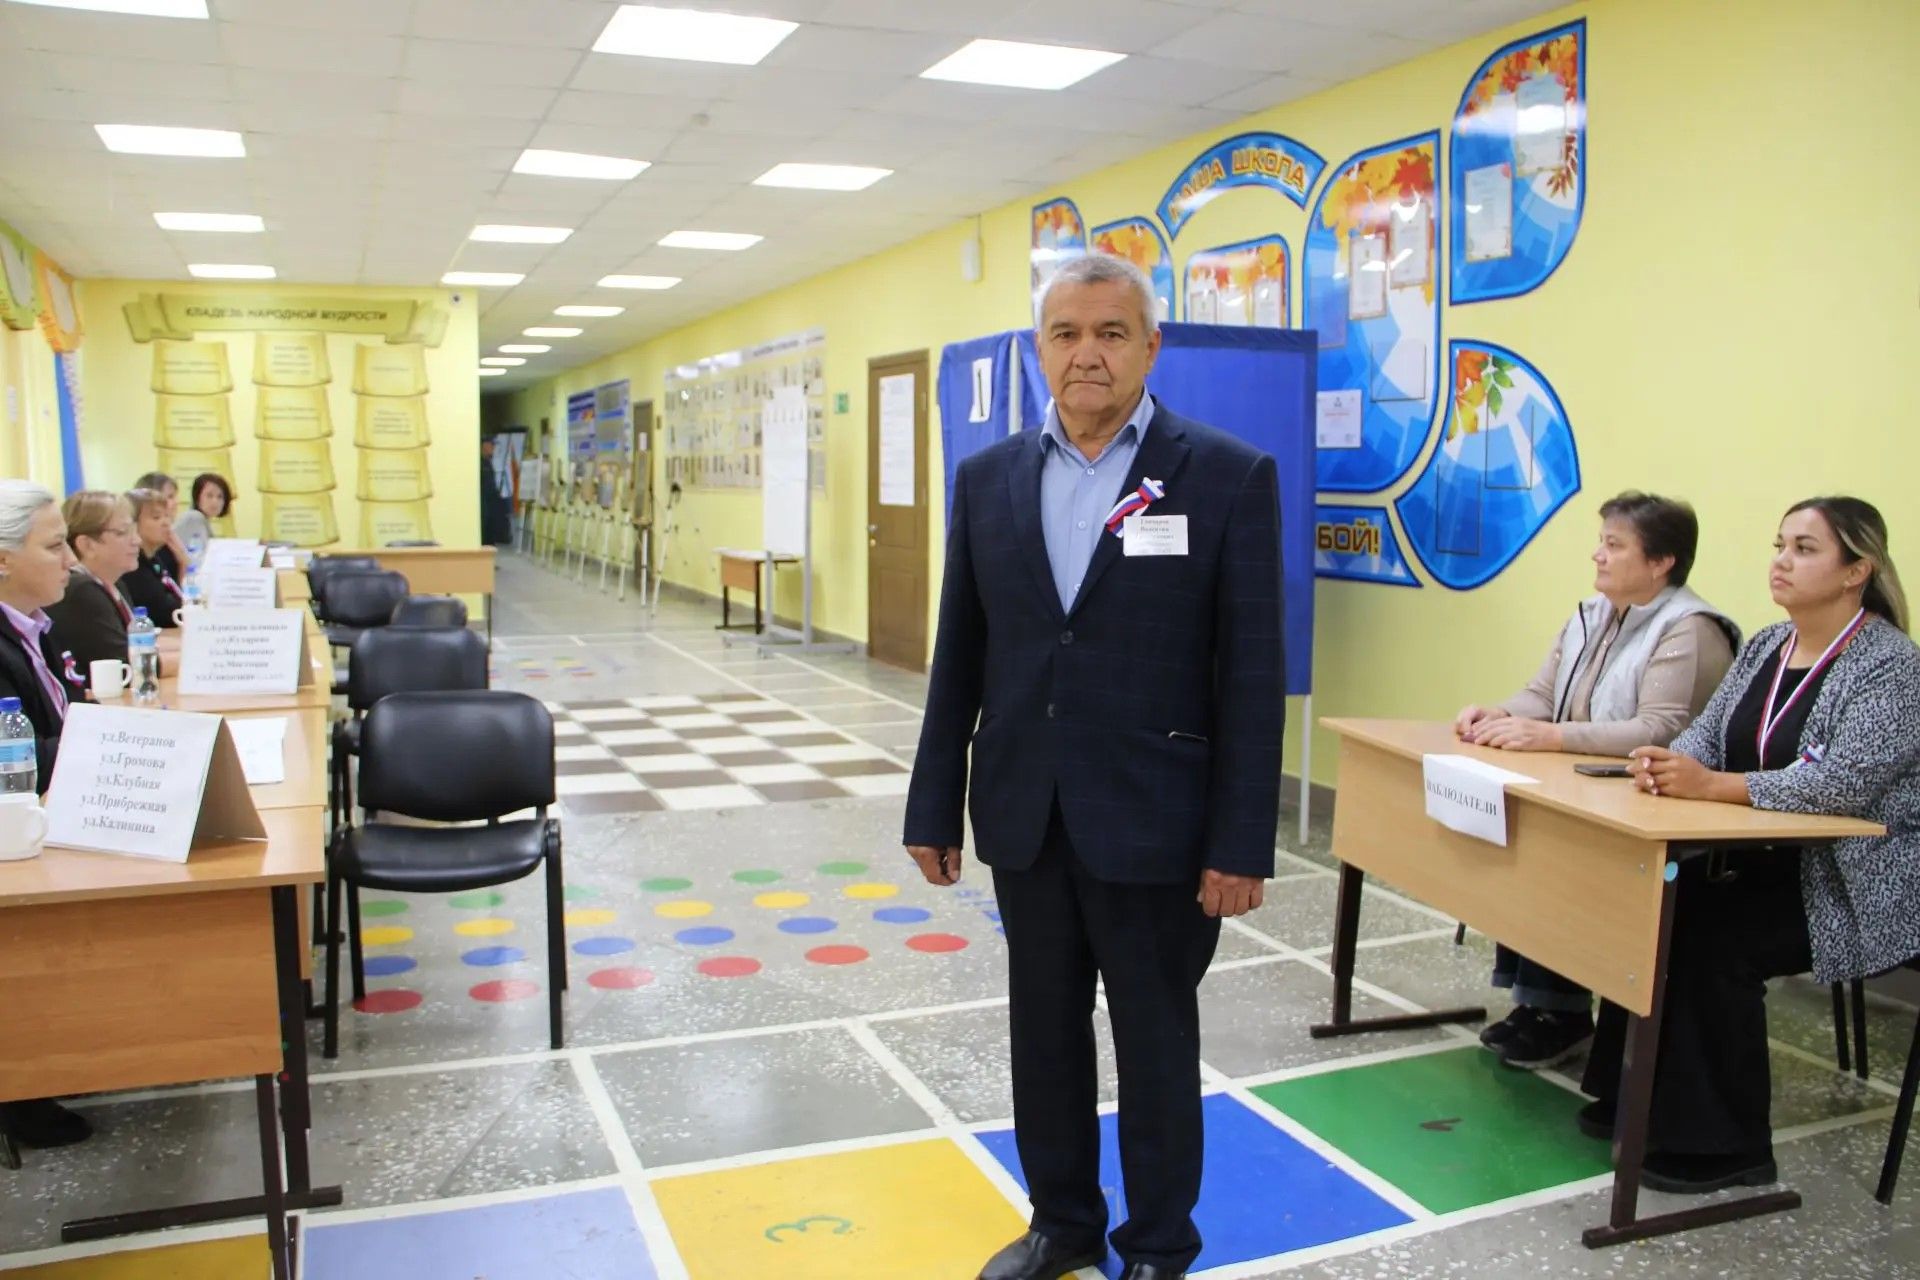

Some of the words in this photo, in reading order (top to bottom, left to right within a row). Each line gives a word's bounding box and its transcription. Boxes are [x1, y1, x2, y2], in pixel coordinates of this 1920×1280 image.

[1231, 148, 1307, 196] ШКОЛА
[247, 307, 317, 321] НАРОДНОЙ
[320, 309, 388, 321] МУДРОСТИ
[1316, 518, 1381, 555] БОЙ!
[101, 731, 176, 749] ул.Ветеранов
[100, 752, 166, 769] ул.Громова
[96, 774, 161, 790] ул.Клубная
[81, 793, 167, 813] ул.Прибрежная
[1426, 780, 1497, 816] НАБЛЮДАТЕЛИ
[82, 816, 156, 834] ул.Калинина
